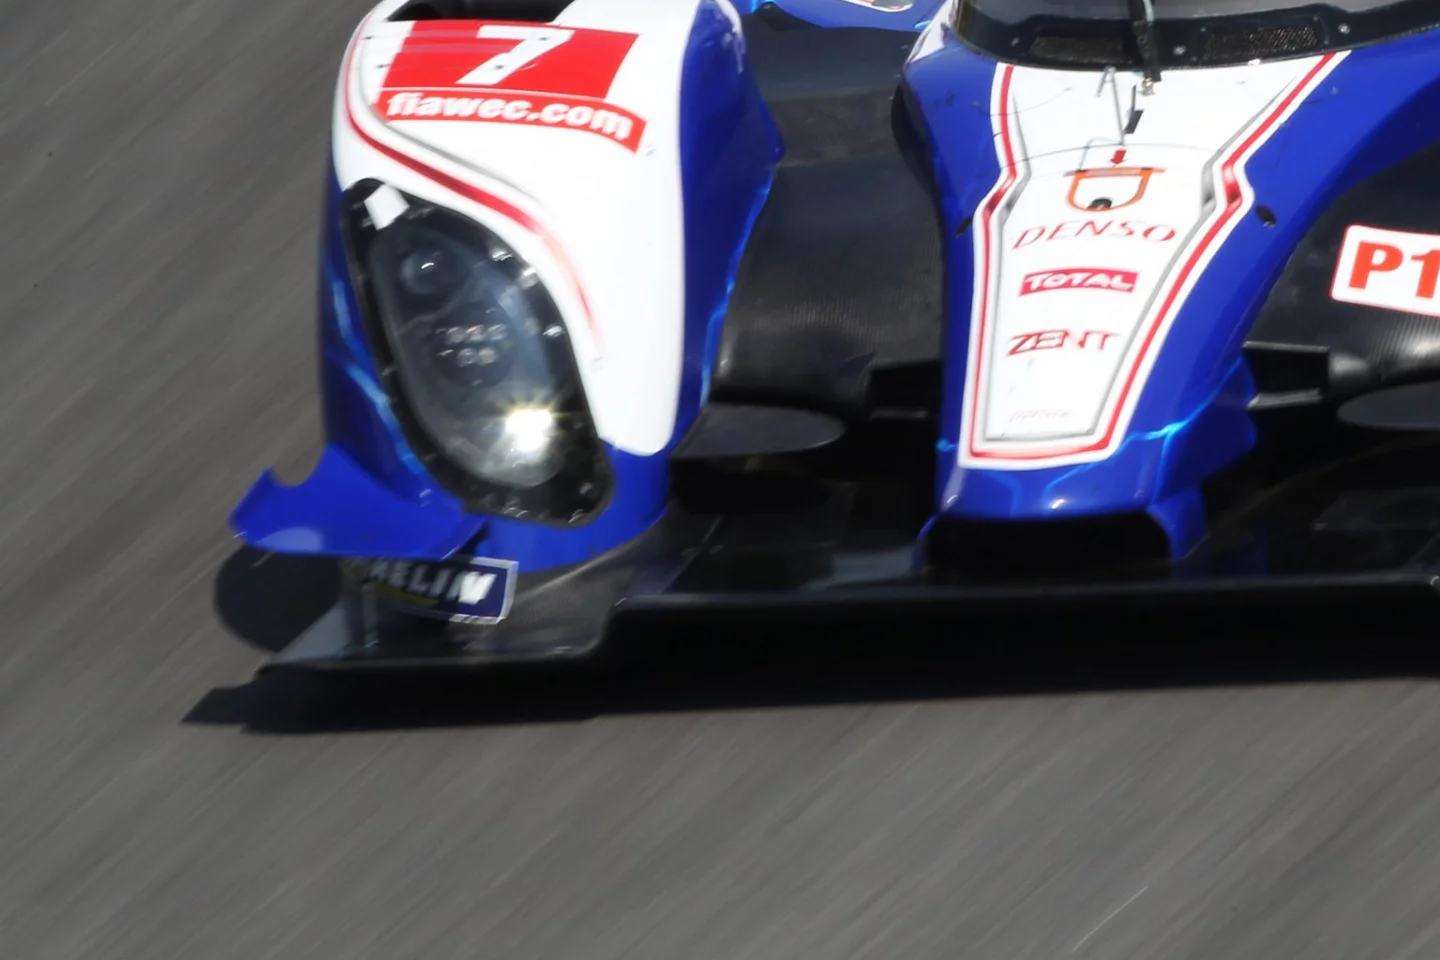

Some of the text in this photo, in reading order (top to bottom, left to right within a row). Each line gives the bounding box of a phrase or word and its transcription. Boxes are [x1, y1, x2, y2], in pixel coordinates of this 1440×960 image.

[455, 24, 576, 86] 7
[385, 91, 634, 141] fiawec.com
[1012, 219, 1177, 250] DENSO
[1025, 271, 1133, 291] TOTAL
[368, 559, 498, 606] HELIN
